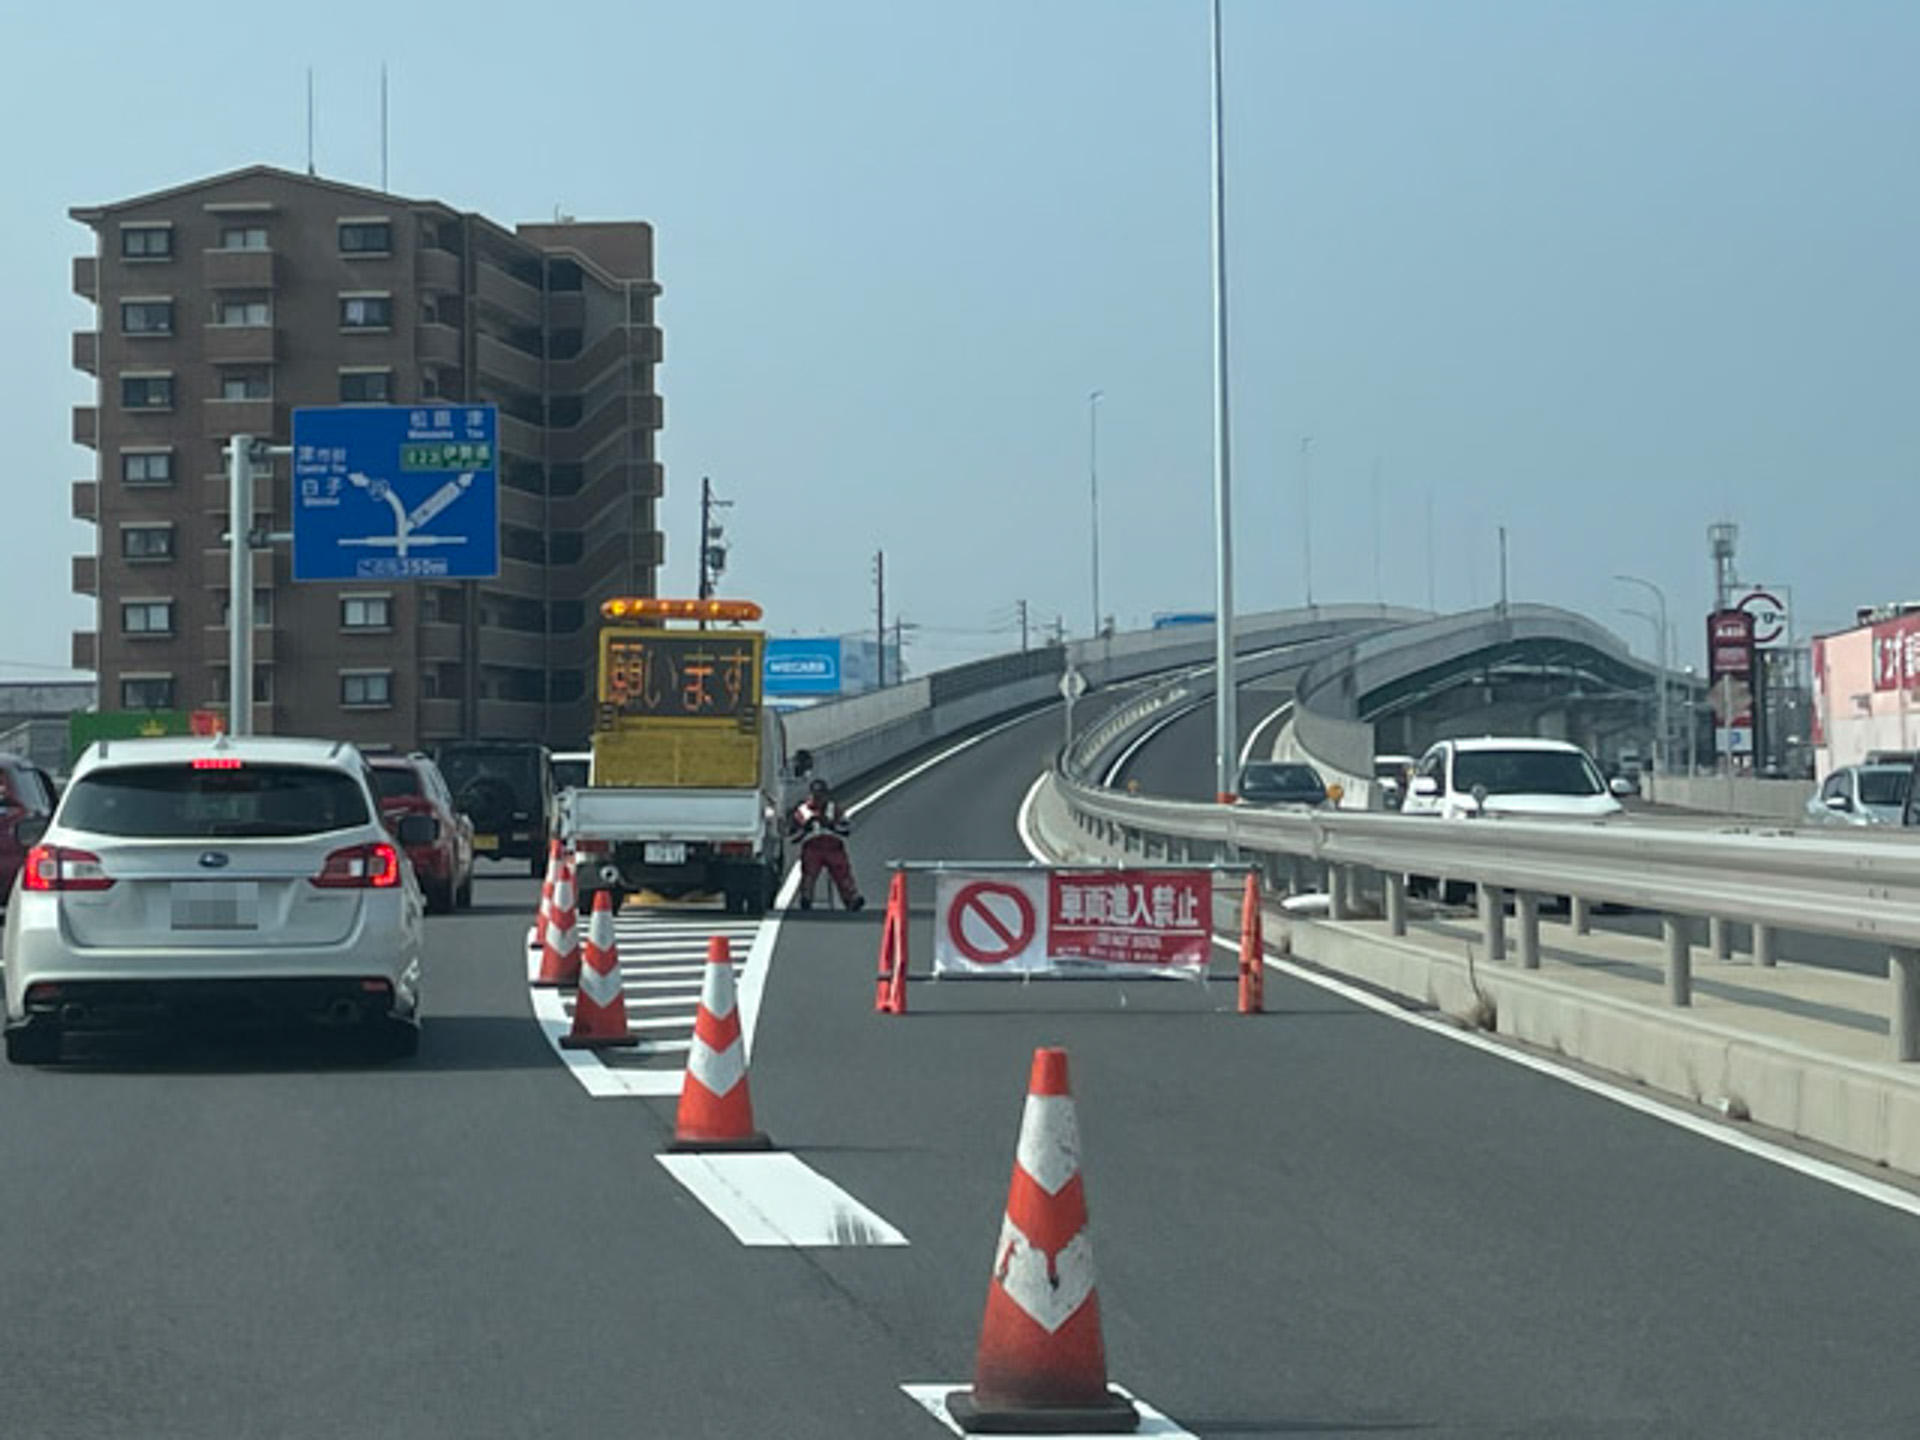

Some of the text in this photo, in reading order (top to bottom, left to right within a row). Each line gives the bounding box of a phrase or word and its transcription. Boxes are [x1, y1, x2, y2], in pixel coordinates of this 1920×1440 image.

[1060, 884, 1199, 927] 車両進入禁止
